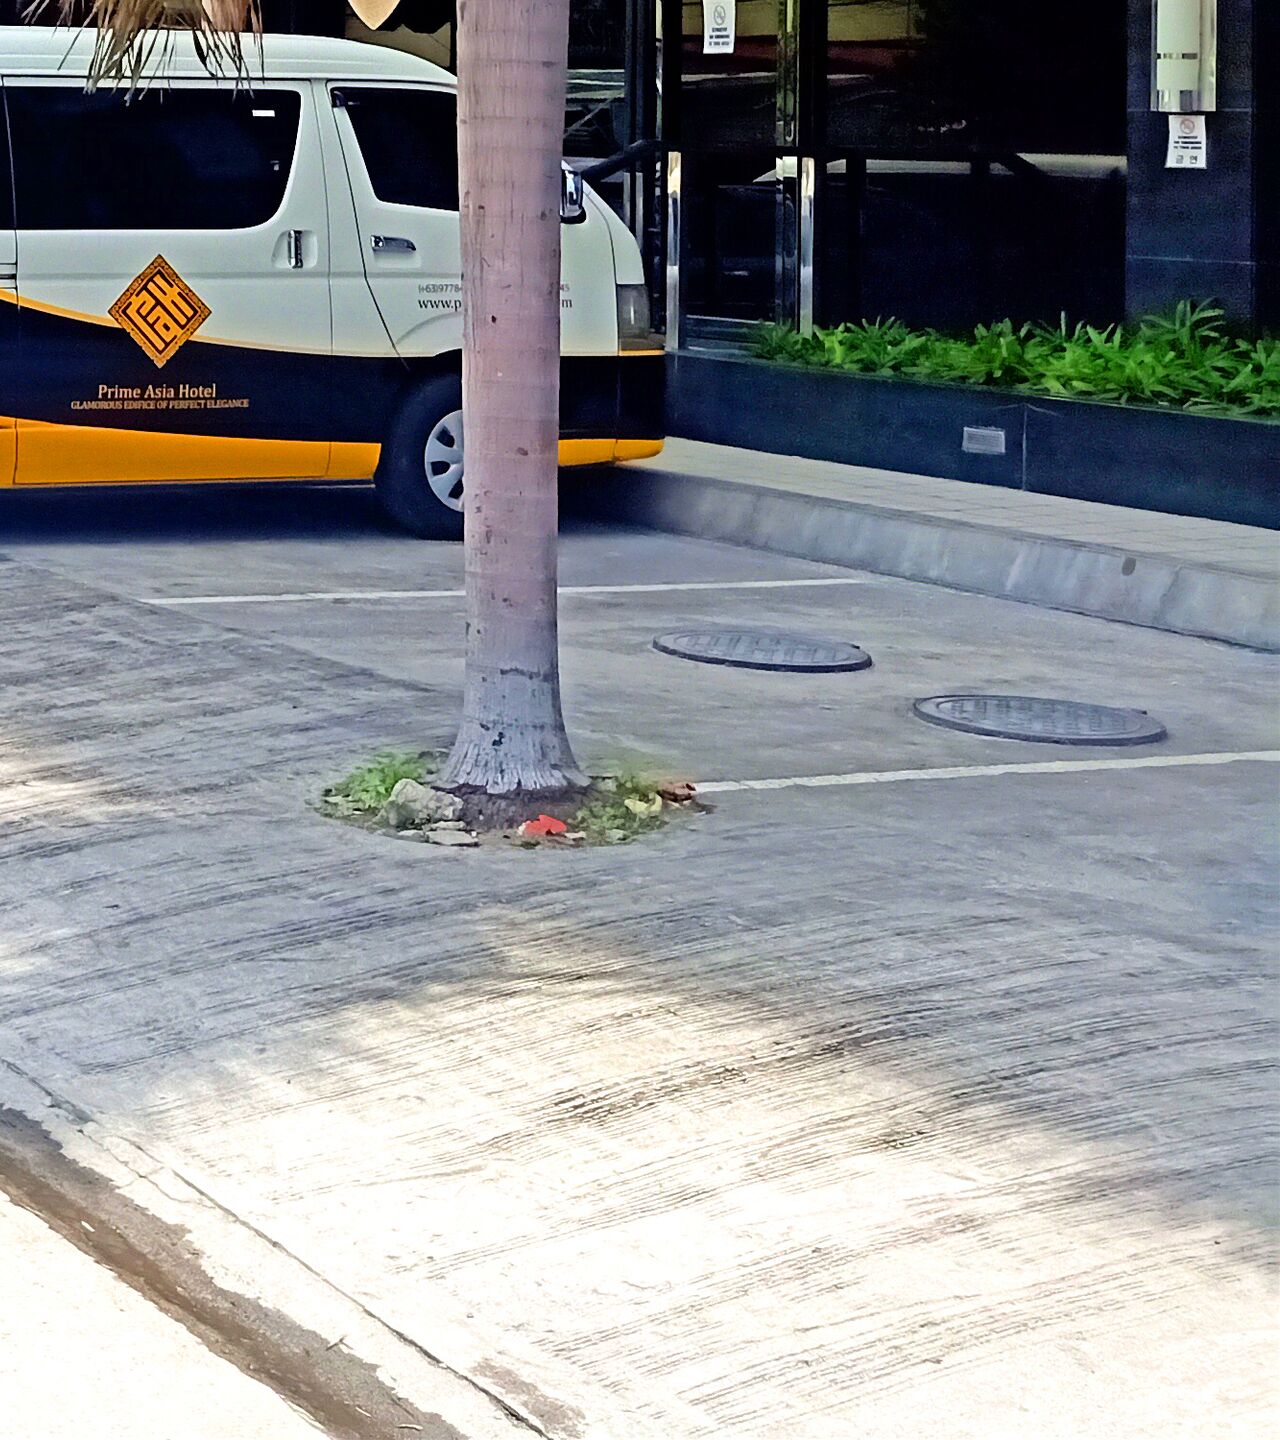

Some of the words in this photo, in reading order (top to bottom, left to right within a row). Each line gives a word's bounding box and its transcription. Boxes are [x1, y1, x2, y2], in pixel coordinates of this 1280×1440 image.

[418, 283, 462, 294] (+63)9778-
[418, 298, 462, 312] www.p
[98, 384, 141, 399] Prime
[144, 384, 174, 399] Asia
[179, 383, 216, 398] Hotel
[71, 401, 123, 410] GLAMOROUS
[124, 400, 155, 410] EDIFICE
[157, 400, 168, 409] OF
[169, 399, 206, 409] PERFECT
[207, 398, 250, 409] ELEGANCE
